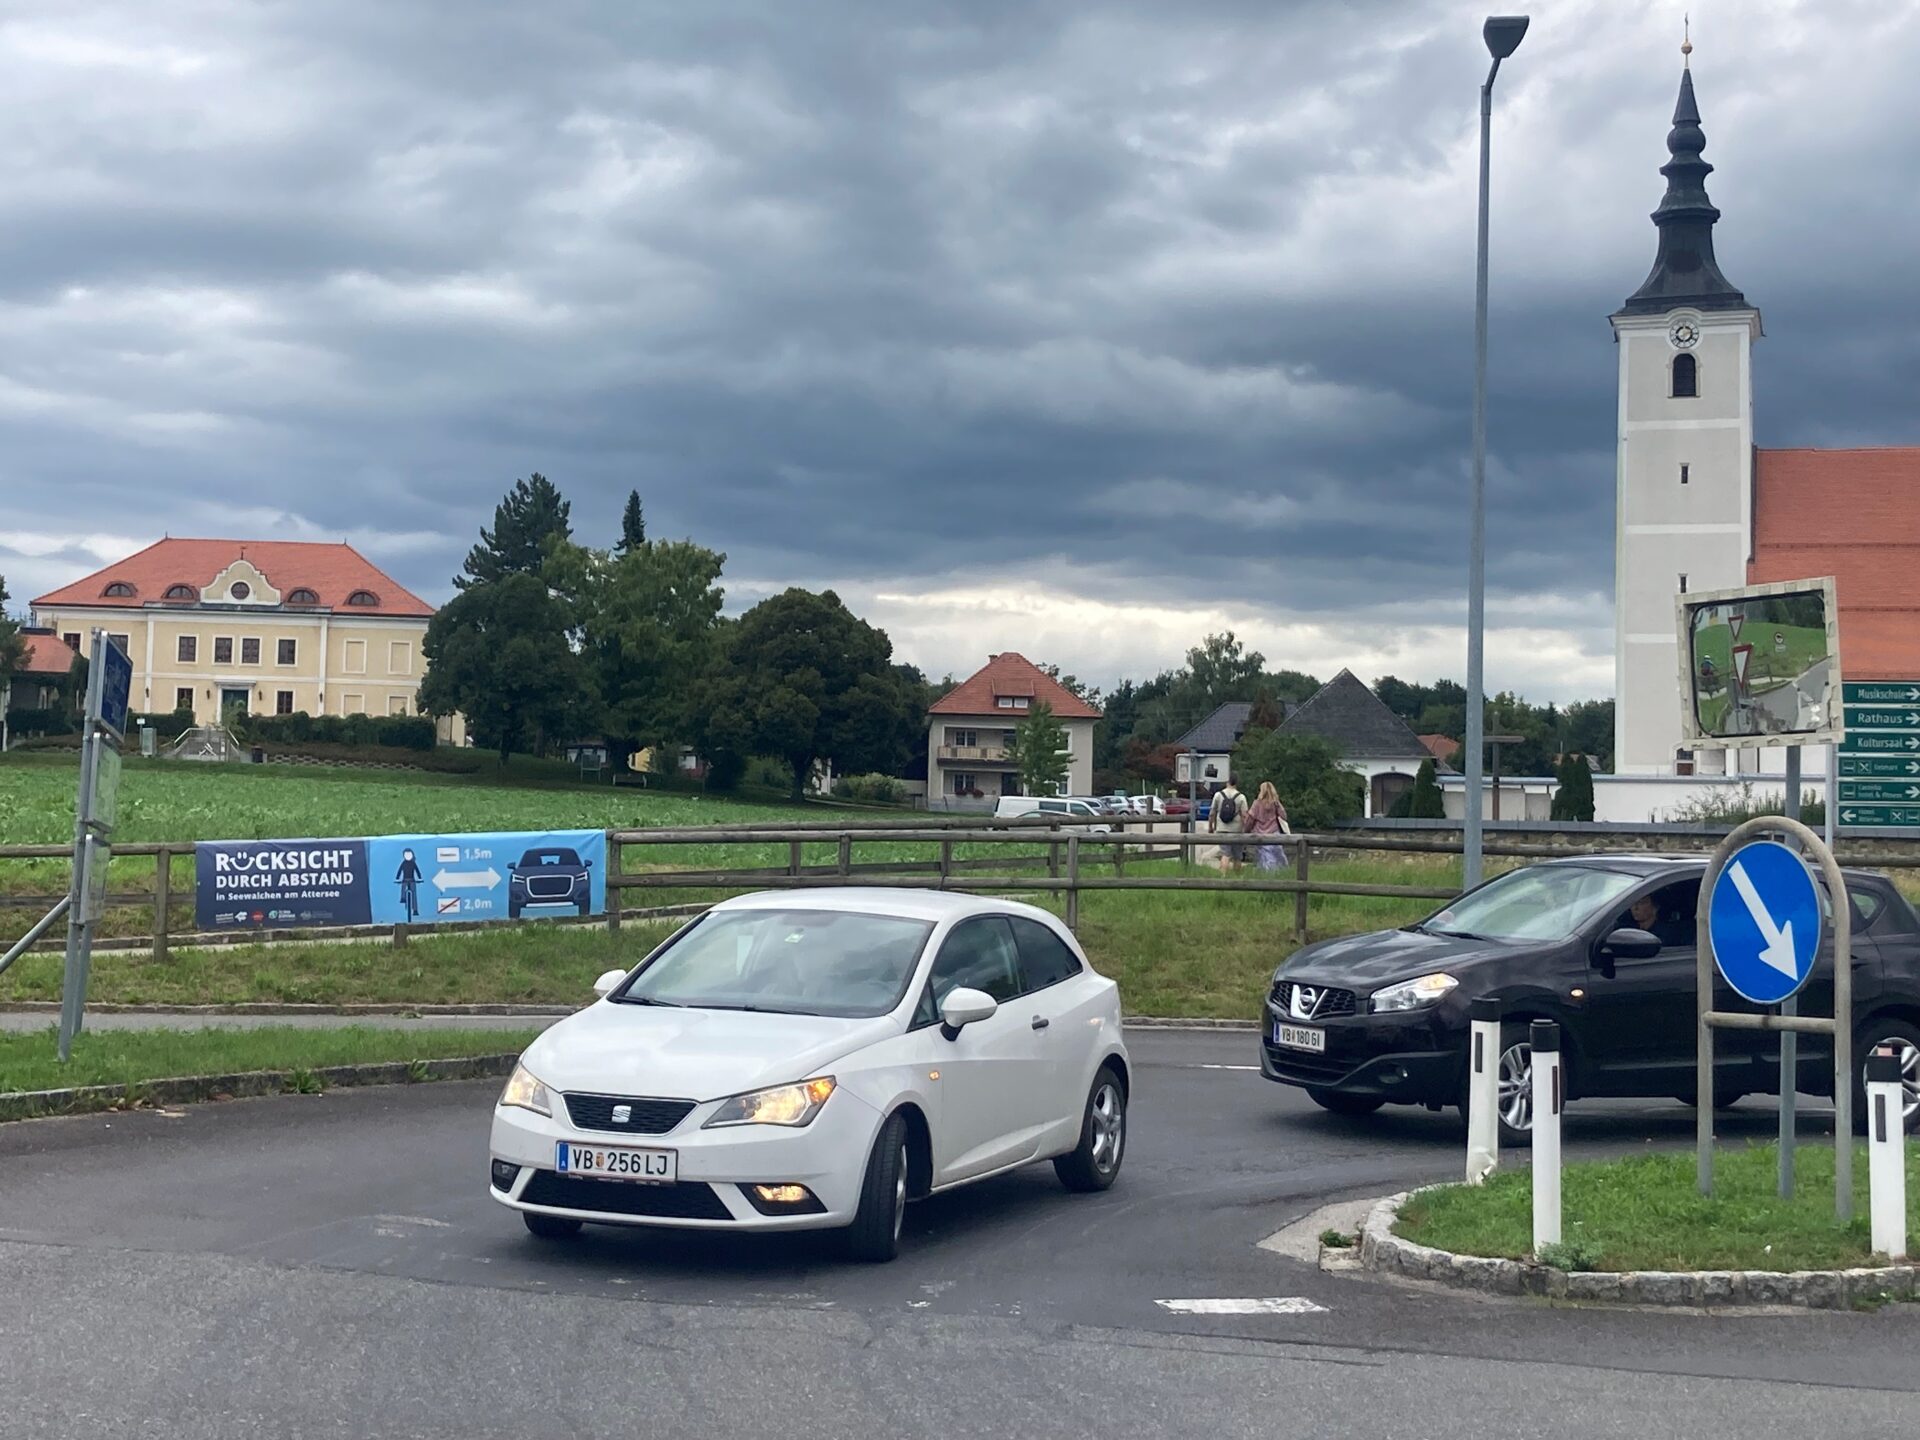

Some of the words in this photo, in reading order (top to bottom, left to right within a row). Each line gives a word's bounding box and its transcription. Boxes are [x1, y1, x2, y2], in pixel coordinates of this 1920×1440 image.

[1858, 688, 1906, 699] Musikschule
[1858, 713, 1903, 724] Rathaus
[1858, 738, 1903, 748] Kultursaal
[464, 847, 493, 861] 1,5m
[216, 874, 272, 889] DURCH
[278, 871, 354, 887] ABSTAND
[216, 892, 226, 901] in
[228, 891, 282, 901] Seewalchen
[284, 891, 299, 900] am
[301, 890, 340, 899] Attersee
[464, 898, 493, 912] 2,0m
[573, 1149, 593, 1170] VB
[607, 1152, 641, 1174] 256
[646, 1154, 668, 1176] LJ
